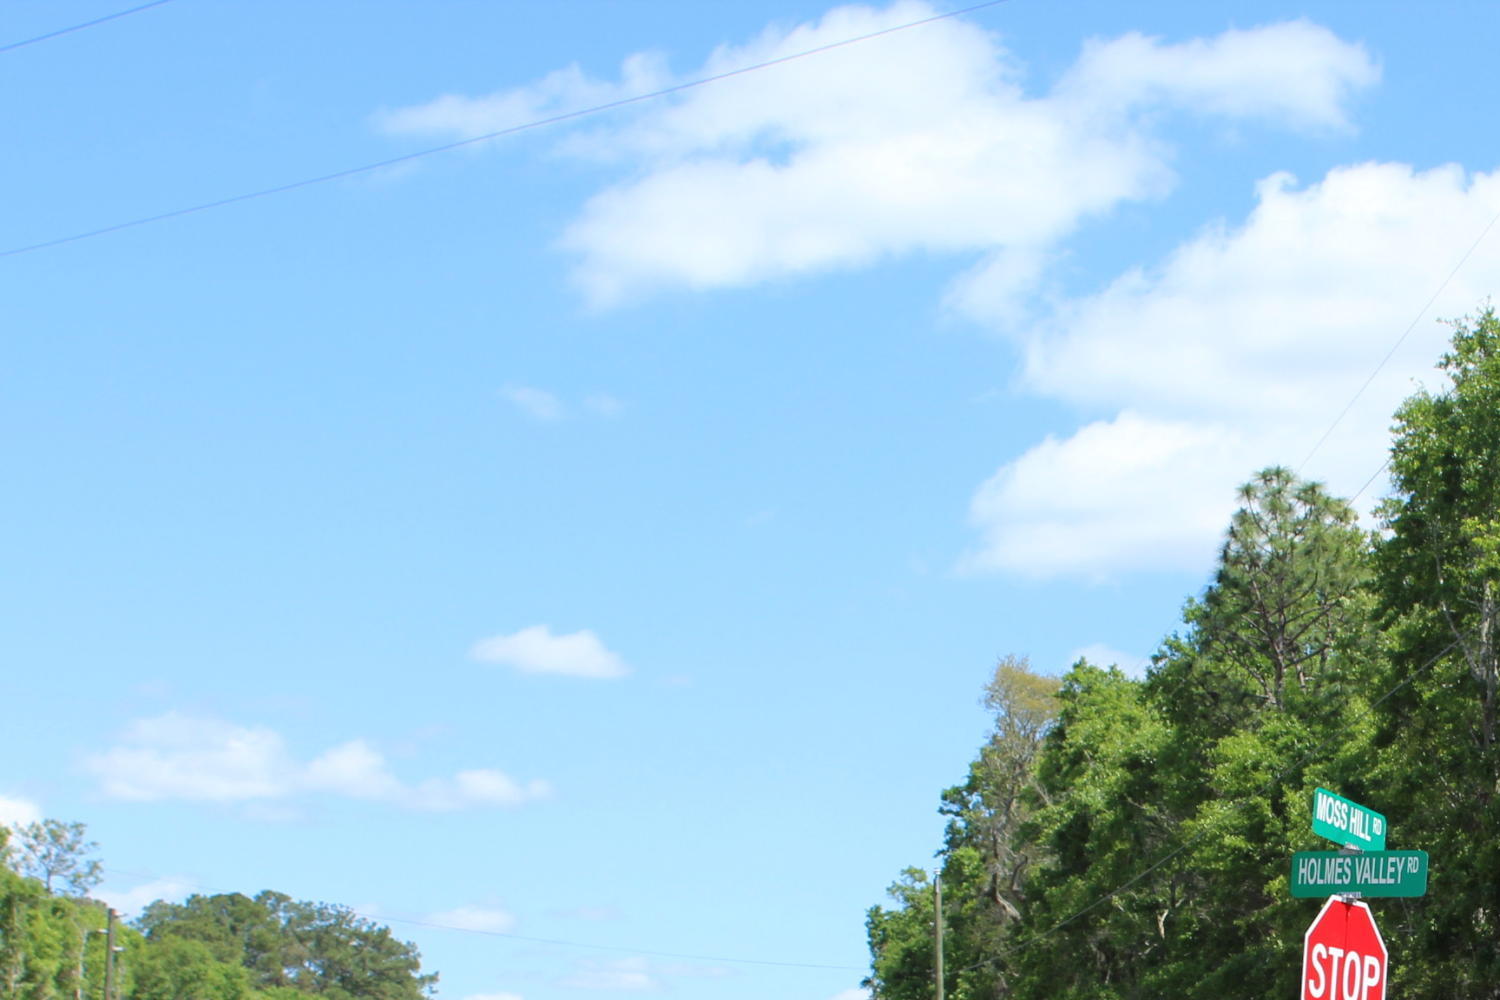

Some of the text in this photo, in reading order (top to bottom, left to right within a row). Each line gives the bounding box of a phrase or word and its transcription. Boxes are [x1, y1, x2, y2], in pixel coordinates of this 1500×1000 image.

[1316, 792, 1382, 841] MOSS HILL RD
[1298, 856, 1419, 885] HOLMES VALLEY RD
